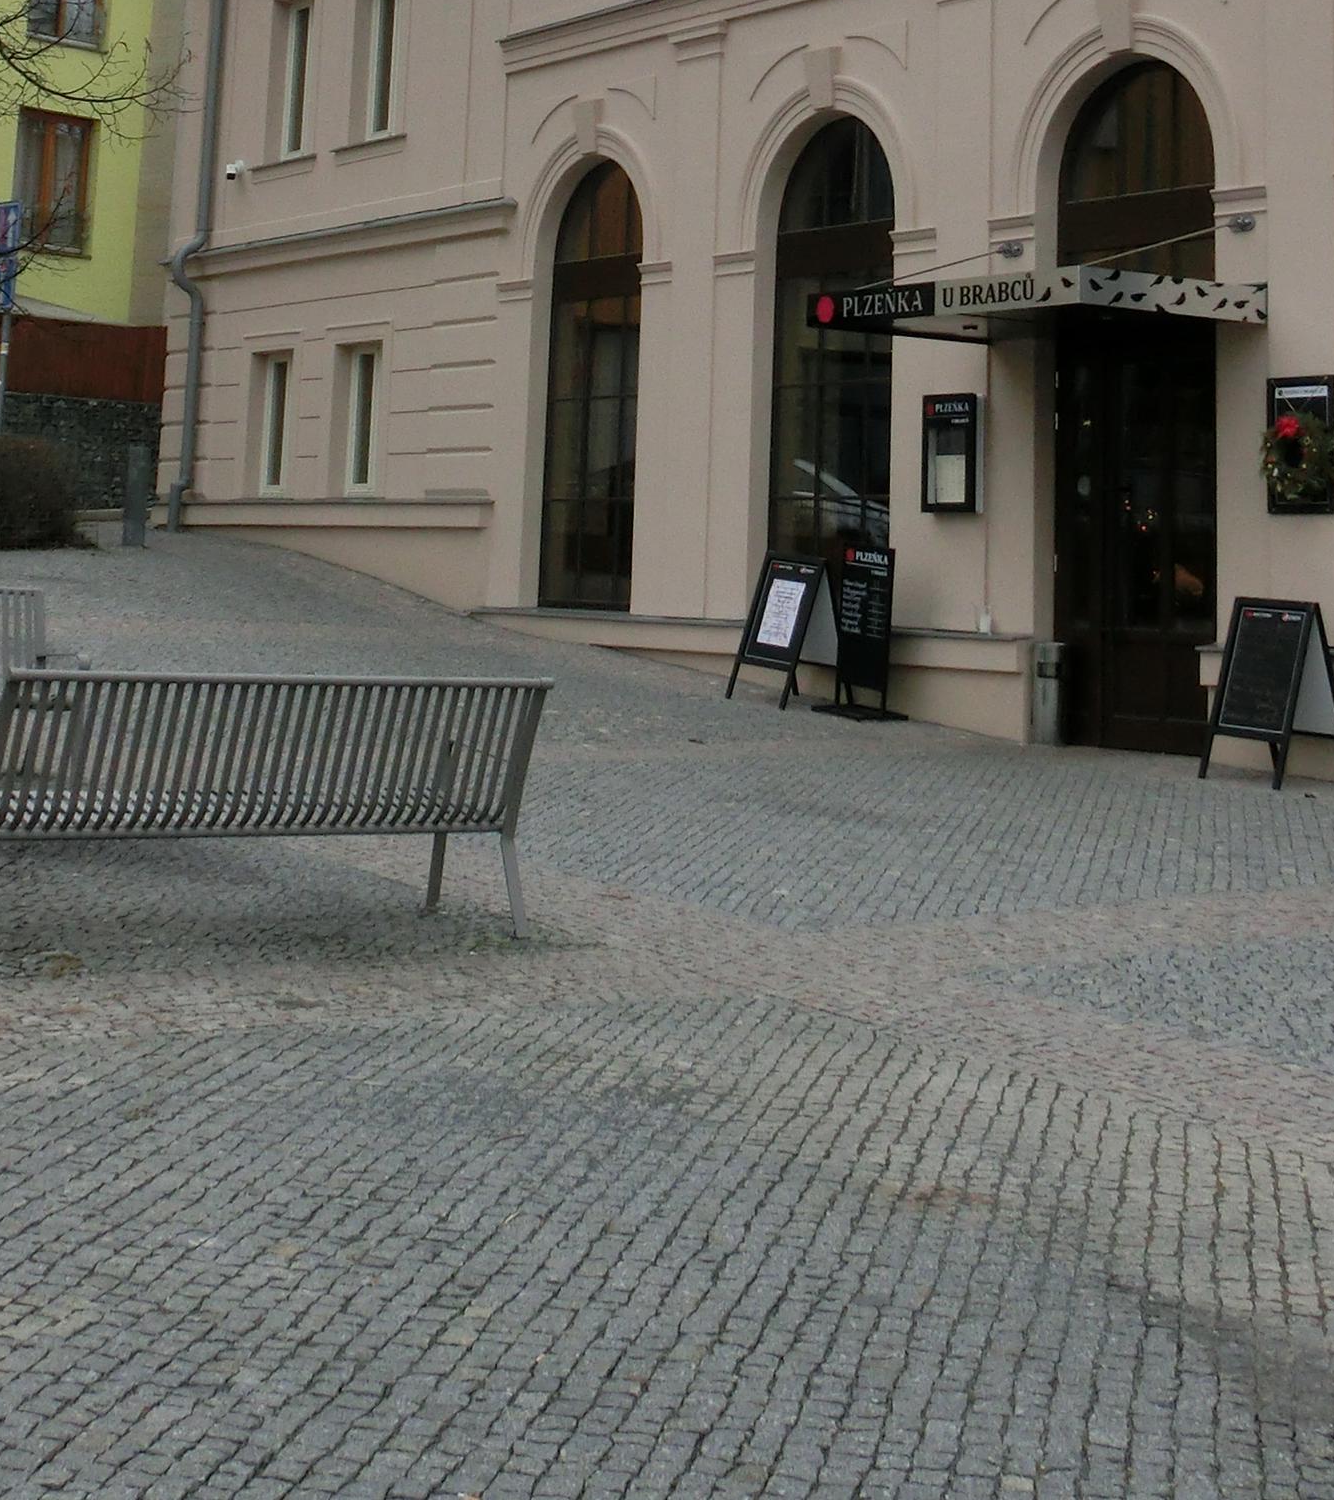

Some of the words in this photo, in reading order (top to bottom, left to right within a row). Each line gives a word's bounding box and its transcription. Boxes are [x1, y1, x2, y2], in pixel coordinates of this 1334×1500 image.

[842, 287, 924, 318] PLZEŇKA
[942, 287, 954, 308] U
[959, 271, 1036, 307] BRABCŮ
[855, 550, 889, 566] PLZEŇKA
